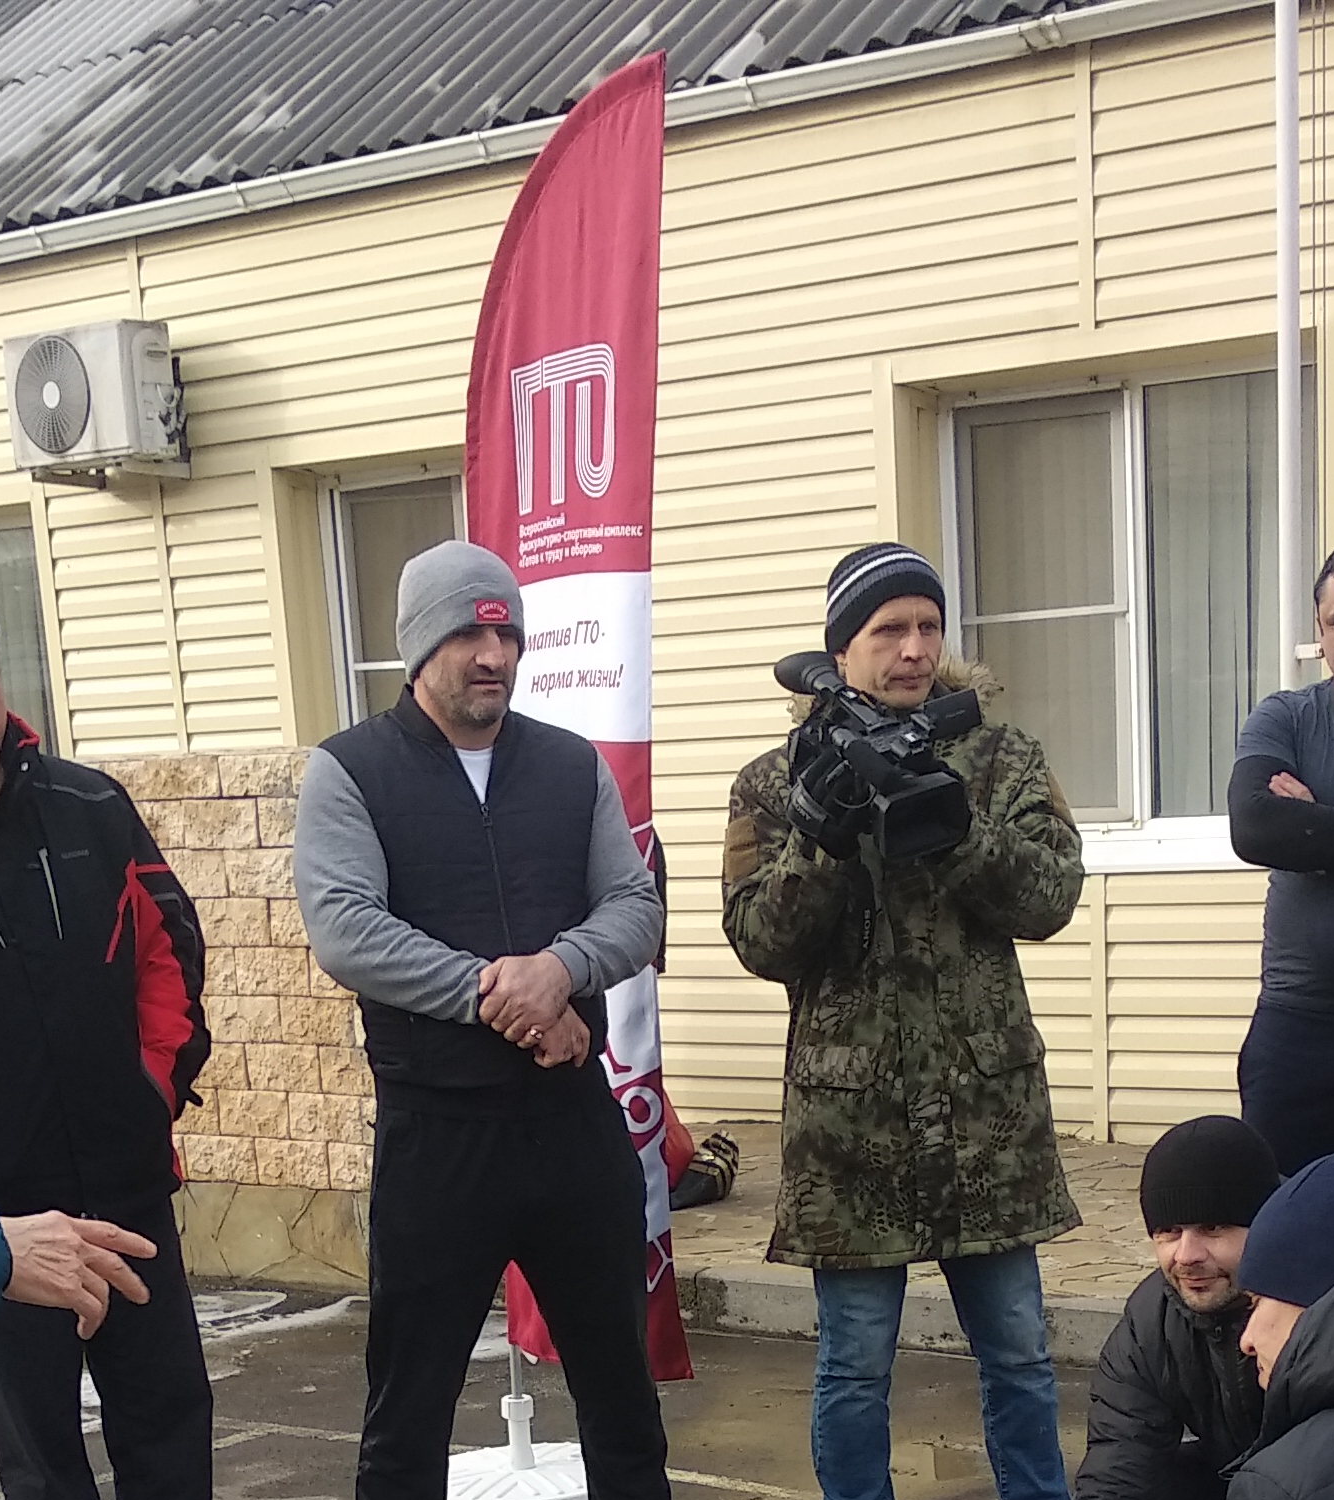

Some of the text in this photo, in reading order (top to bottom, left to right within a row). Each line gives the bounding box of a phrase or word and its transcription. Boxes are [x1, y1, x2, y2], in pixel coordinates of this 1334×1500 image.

[510, 343, 615, 516] ГТО
[519, 512, 565, 538] Всероссийский
[531, 663, 624, 698] норма жизни!
